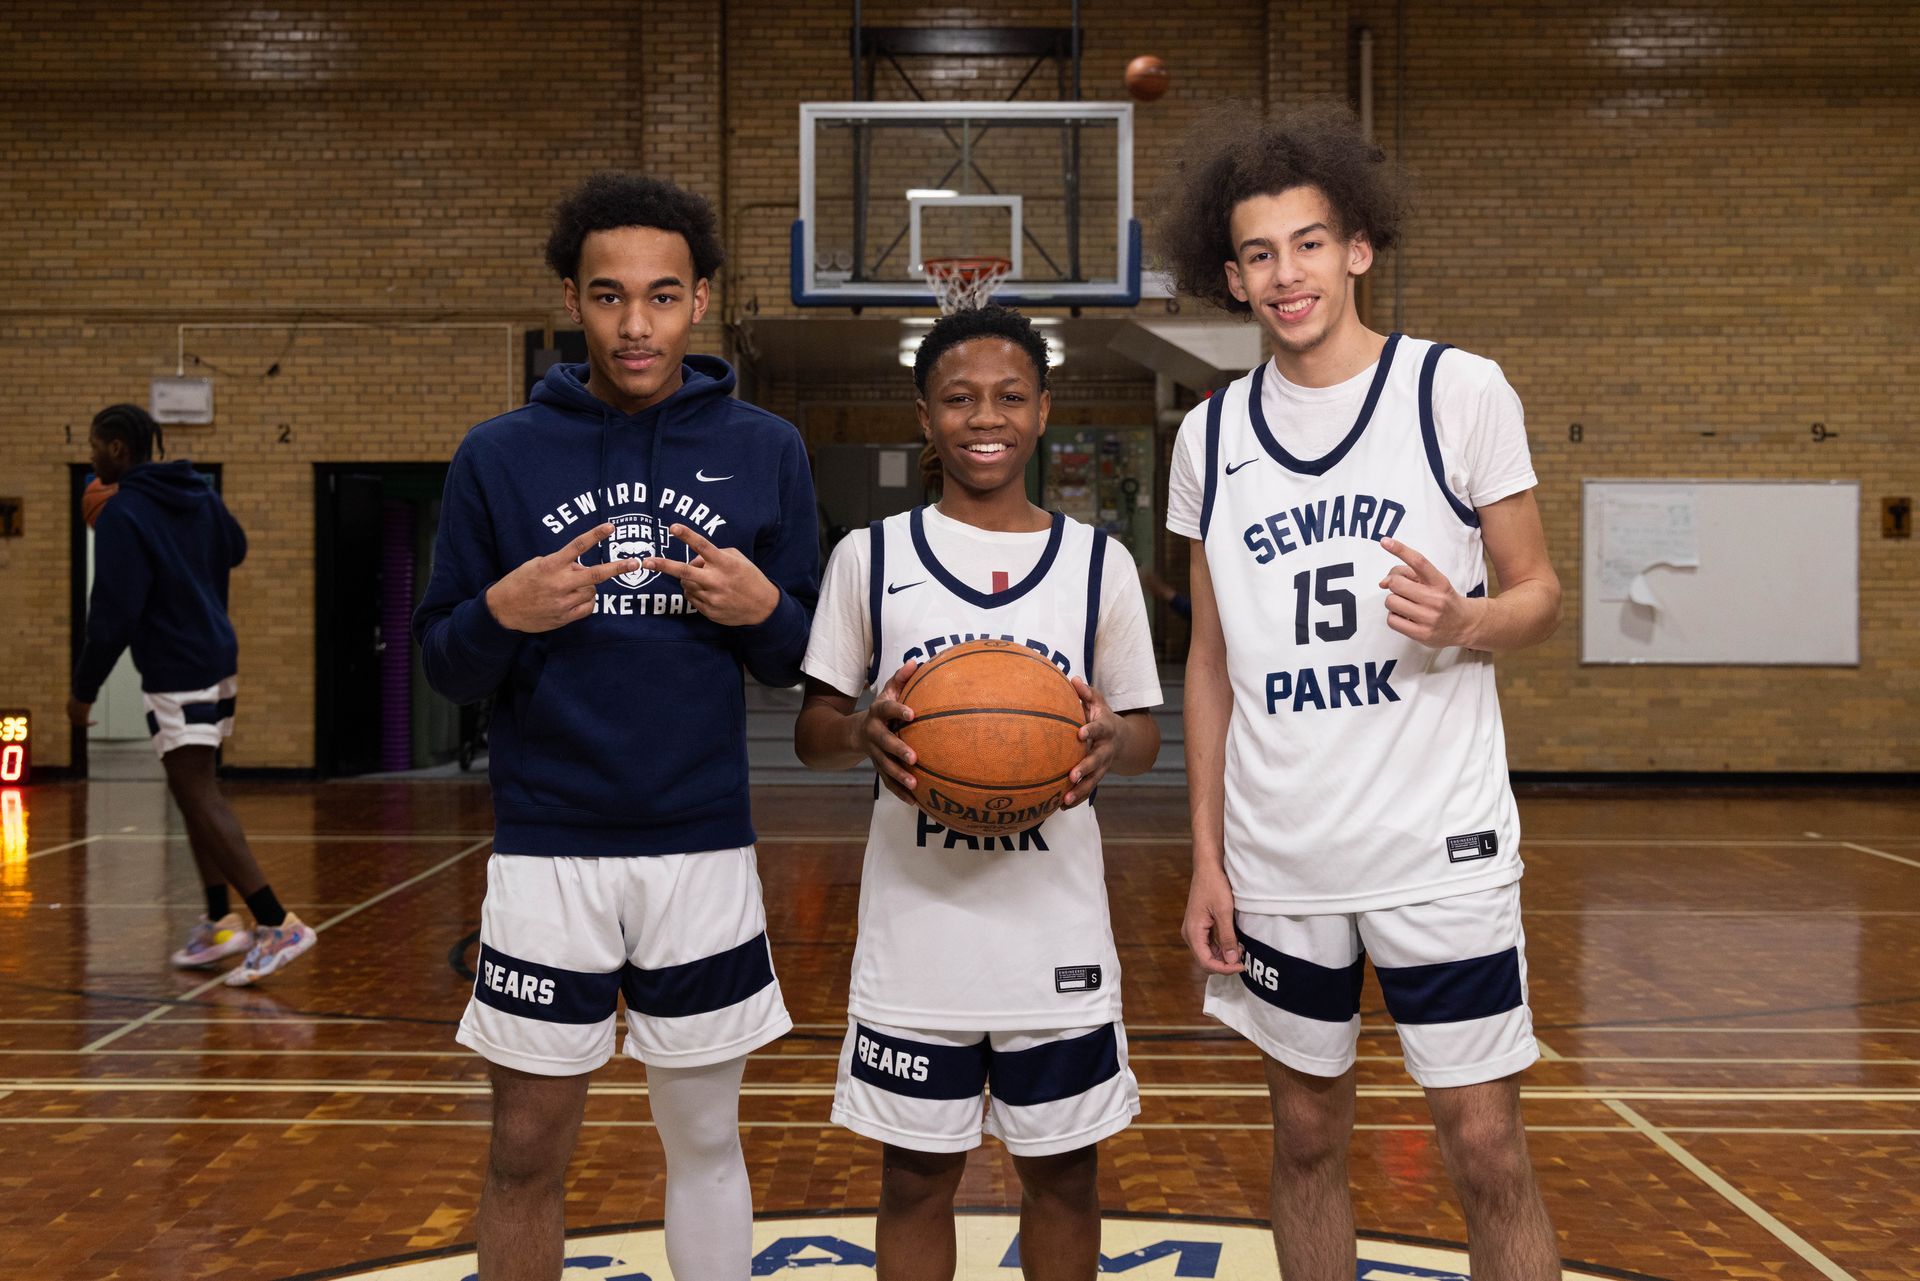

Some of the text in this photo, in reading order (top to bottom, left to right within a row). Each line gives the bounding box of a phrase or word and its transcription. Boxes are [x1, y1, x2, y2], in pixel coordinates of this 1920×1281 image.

[65, 425, 72, 444] 1
[277, 424, 292, 444] 2
[1568, 422, 1584, 444] 8
[1811, 422, 1826, 442] 9
[659, 488, 727, 537] PARK
[1243, 494, 1406, 565] SEWARD
[1293, 562, 1358, 646] 15
[1265, 659, 1402, 715] PARK
[926, 788, 1062, 825] SPALDING
[1484, 839, 1493, 850] L
[485, 960, 556, 1006] BEARS
[1091, 973, 1098, 984] S
[1244, 951, 1279, 991] ARS
[858, 1034, 930, 1082] BEARS
